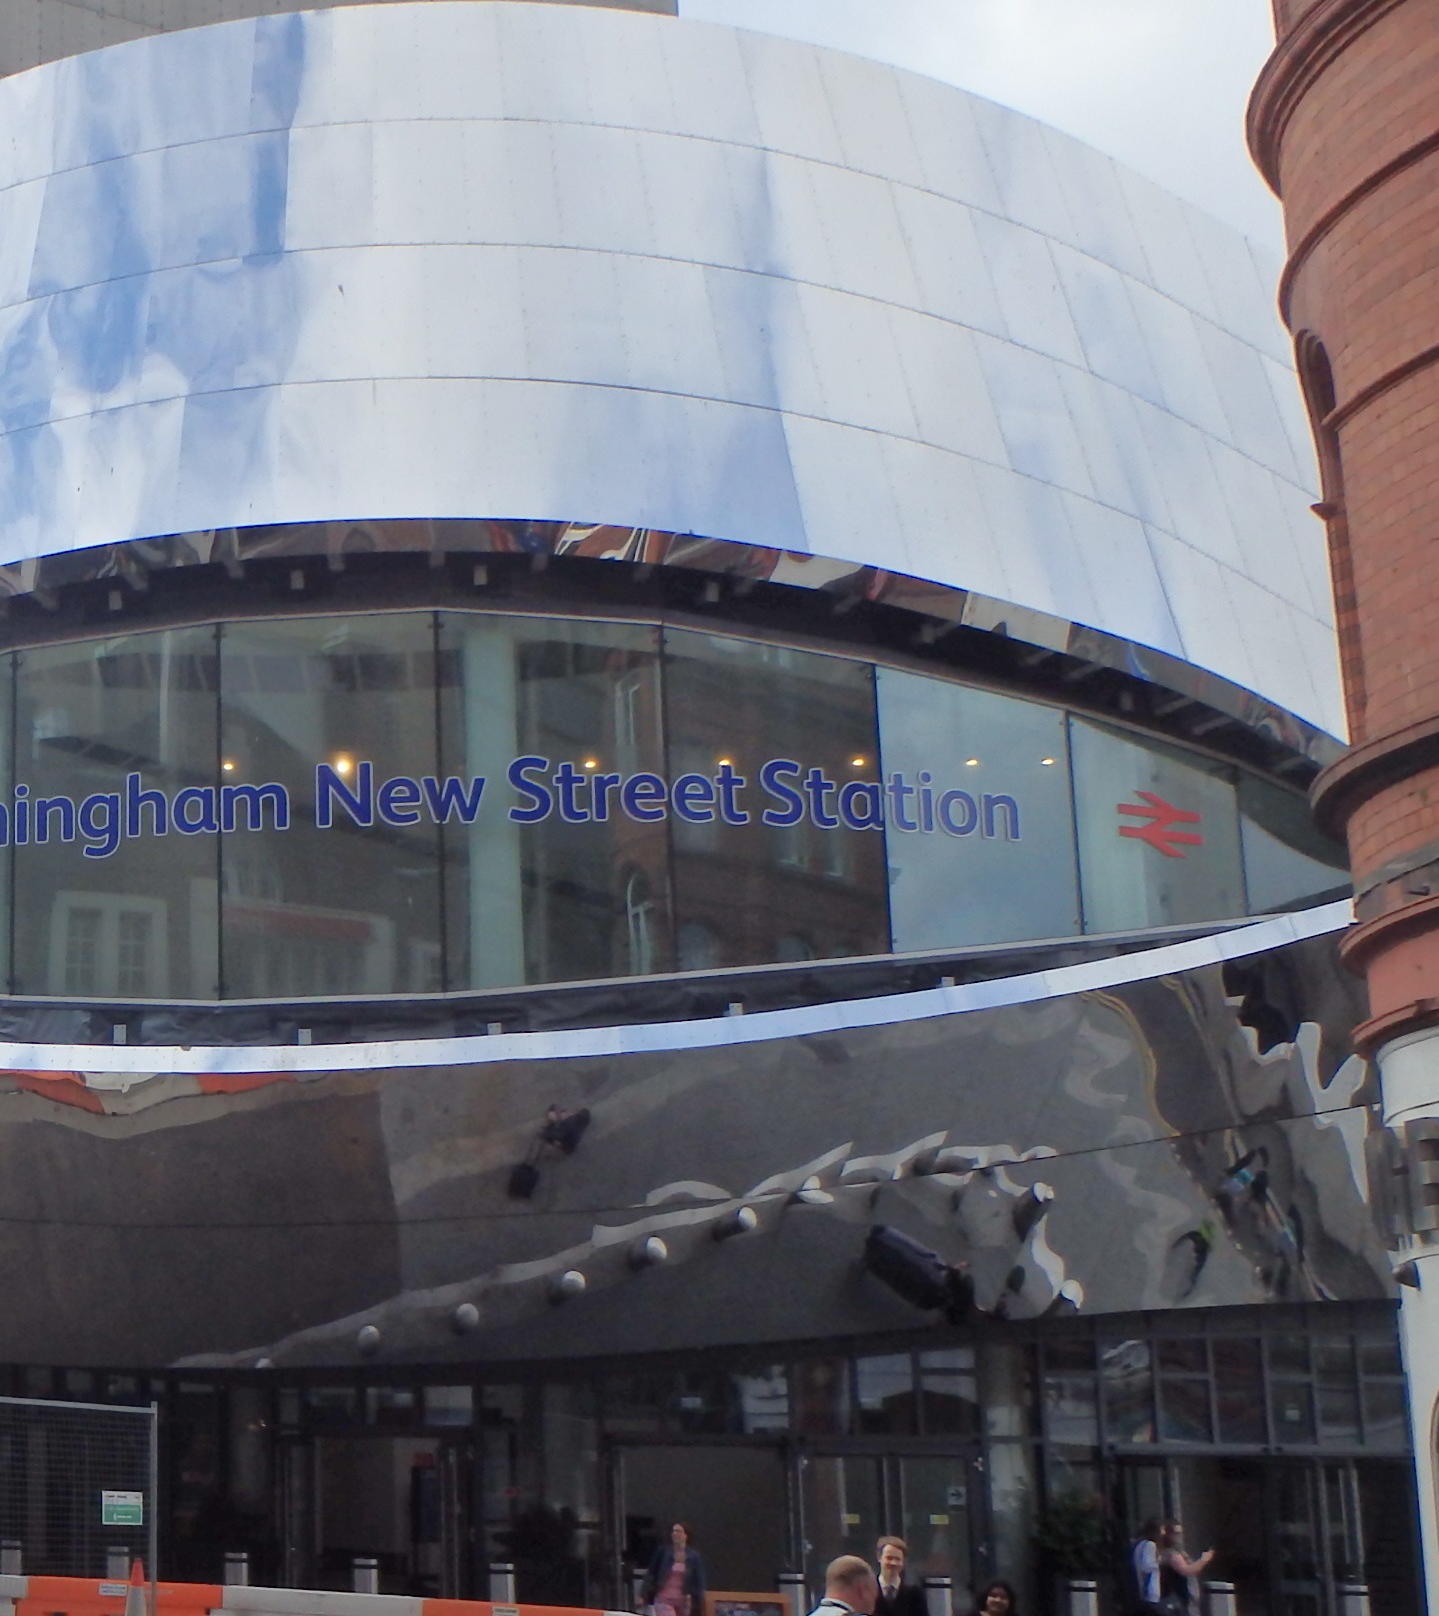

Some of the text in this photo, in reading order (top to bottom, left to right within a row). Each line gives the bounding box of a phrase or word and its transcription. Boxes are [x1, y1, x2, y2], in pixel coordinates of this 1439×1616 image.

[315, 761, 485, 829] New
[506, 755, 749, 825] Street
[761, 758, 1021, 842] Station
